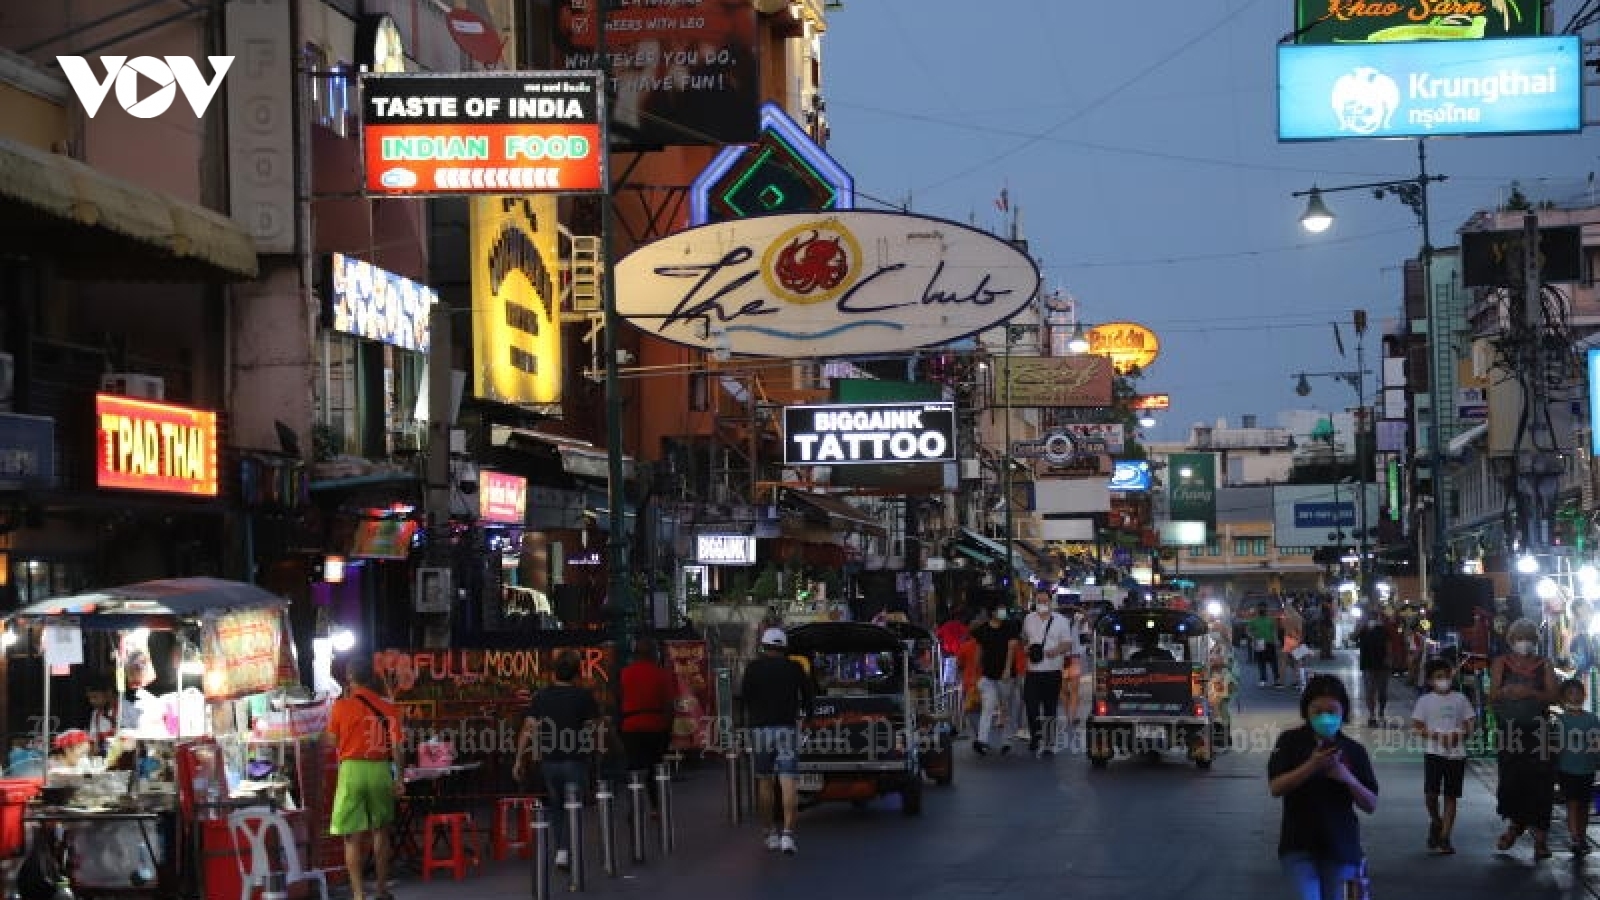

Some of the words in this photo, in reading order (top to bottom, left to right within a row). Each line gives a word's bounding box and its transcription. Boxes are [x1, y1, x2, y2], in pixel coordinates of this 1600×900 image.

[680, 18, 705, 29] LEO
[663, 50, 699, 67] YOU
[681, 74, 724, 92] FUN!
[1409, 68, 1557, 103] Krungthai
[372, 97, 458, 117] TASTE
[465, 98, 500, 118] OF
[509, 98, 585, 119] INDIA
[382, 135, 489, 160] INDIAN
[505, 135, 590, 160] FOOD
[654, 246, 779, 332] The
[836, 260, 1012, 313] Club
[814, 409, 924, 431] BIGGAINK
[160, 422, 204, 480] THAI
[793, 431, 947, 461] TATTOO
[413, 652, 477, 680] FULL
[483, 649, 540, 678] MOON
